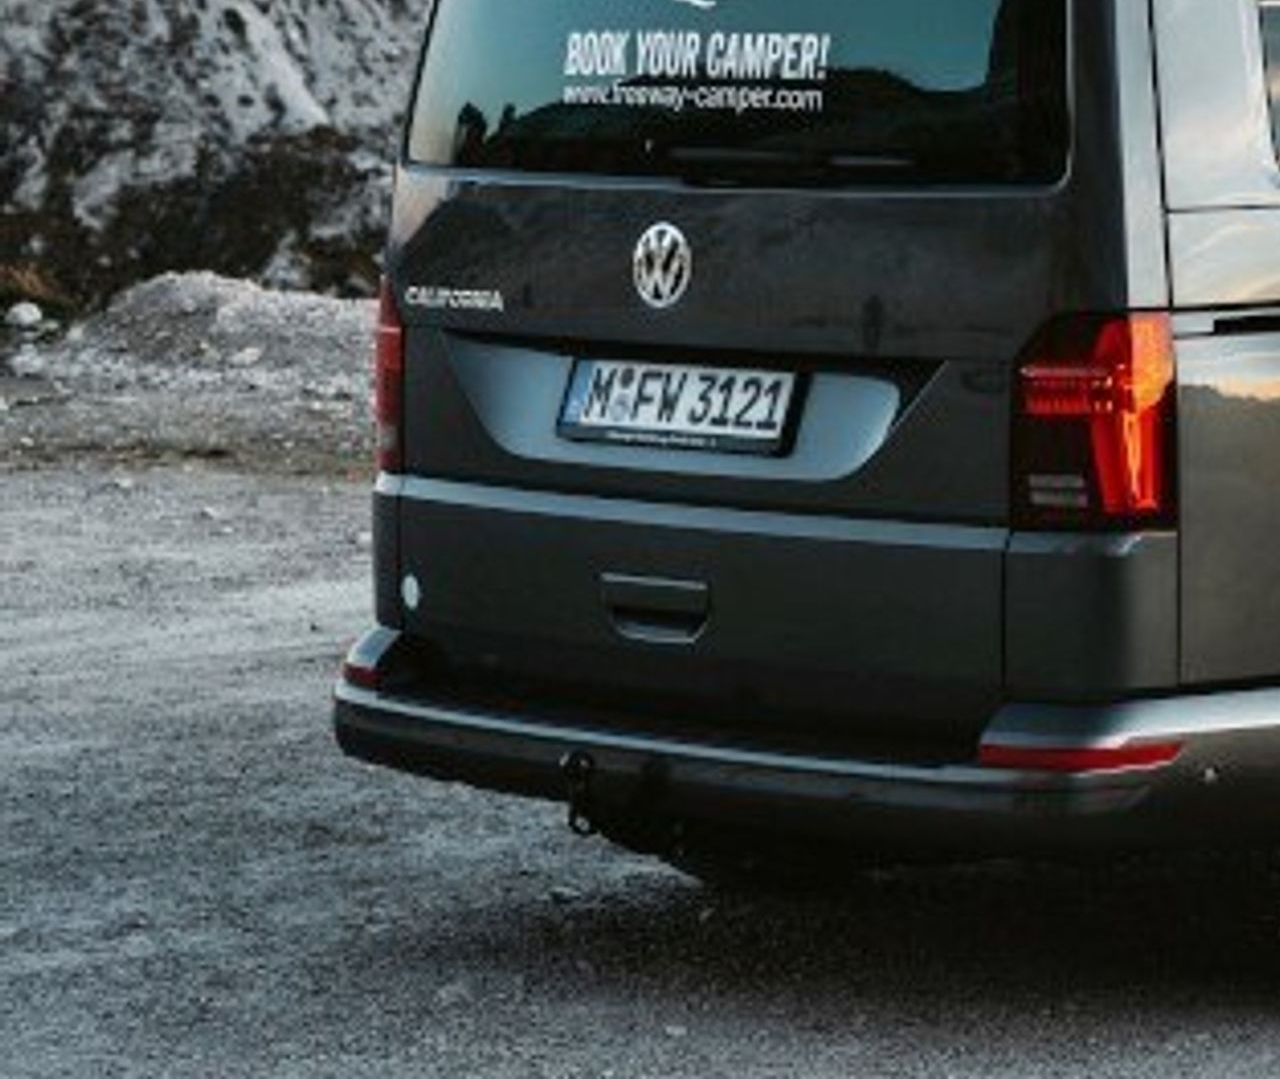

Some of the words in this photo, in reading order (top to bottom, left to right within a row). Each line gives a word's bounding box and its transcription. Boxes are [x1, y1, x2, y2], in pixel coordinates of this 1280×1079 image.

[563, 31, 631, 76] BOOK
[635, 31, 700, 77] YOUR
[705, 32, 831, 81] CAMPER!
[562, 79, 823, 114] www.freeway-camper.com
[687, 374, 784, 431] 3121
